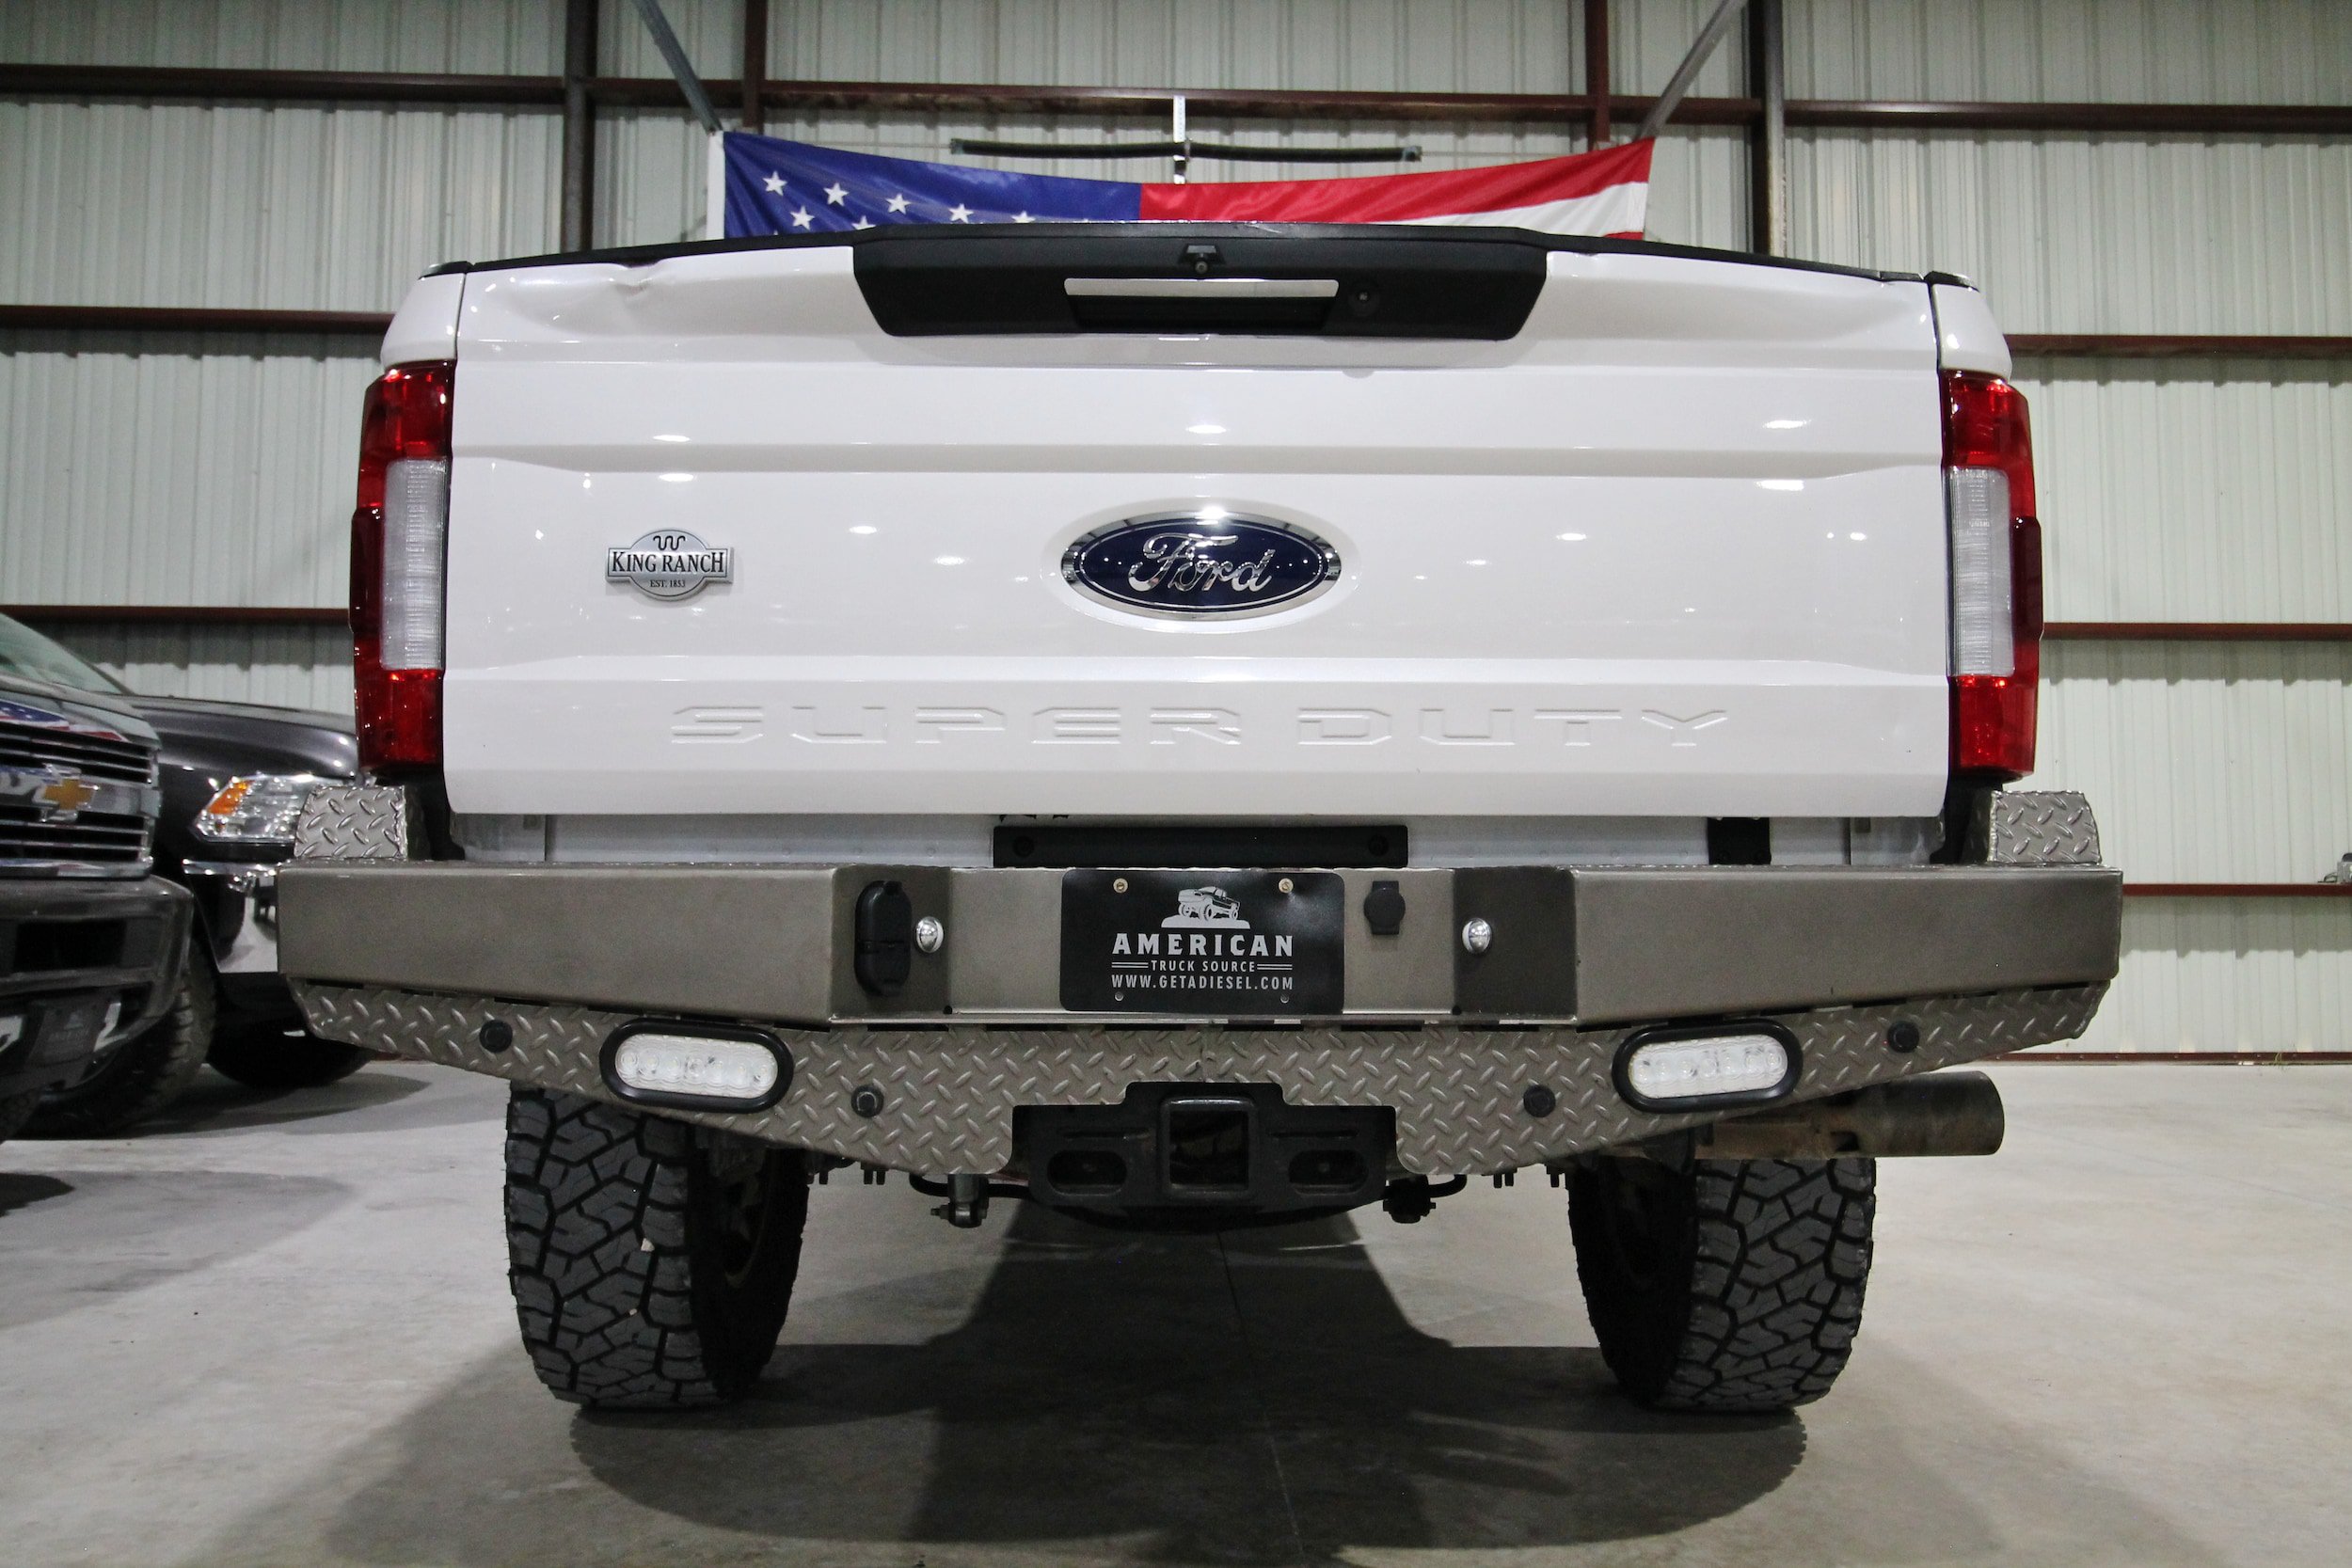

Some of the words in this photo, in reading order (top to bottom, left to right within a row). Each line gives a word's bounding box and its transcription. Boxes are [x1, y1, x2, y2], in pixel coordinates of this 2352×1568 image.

[612, 551, 657, 573] KING
[661, 551, 724, 573] RANCH
[1128, 531, 1276, 592] Ford
[650, 579, 667, 588] EST.
[669, 579, 686, 588] 1853
[671, 705, 1242, 745] SUPER
[1297, 707, 1728, 747] DUTY
[1111, 932, 1294, 958] AMERICAN
[1151, 959, 1196, 972] TRUCK
[1202, 960, 1256, 973] SOURCE
[1111, 974, 1294, 990] WWW.GETADIESEL.COM
